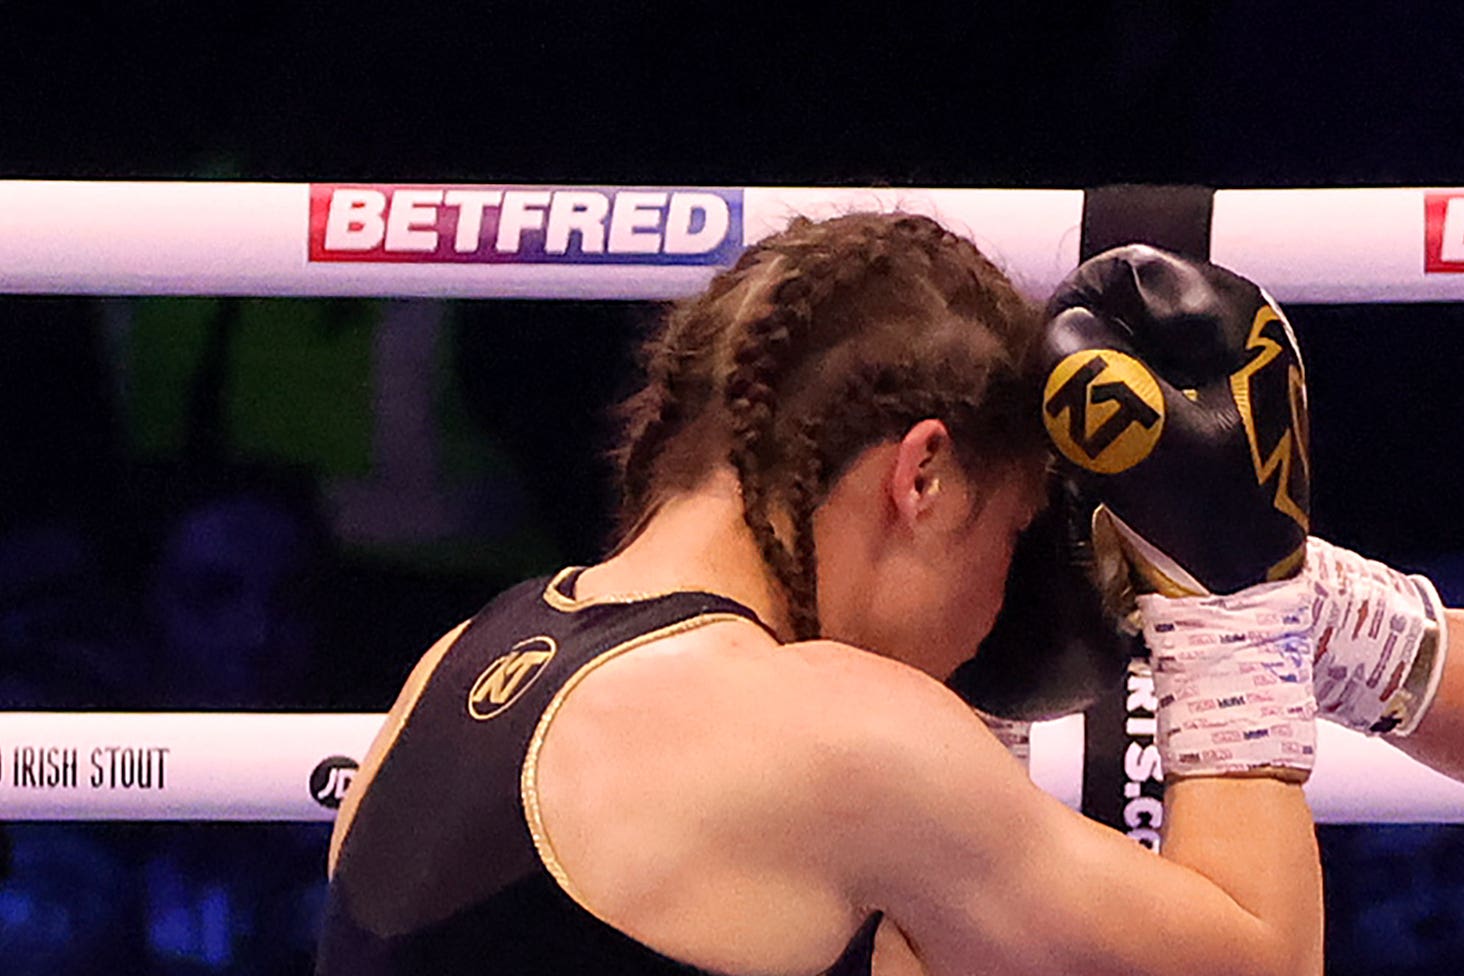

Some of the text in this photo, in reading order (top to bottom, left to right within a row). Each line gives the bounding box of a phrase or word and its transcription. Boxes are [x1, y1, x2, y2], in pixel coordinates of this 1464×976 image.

[323, 188, 730, 255] BETFRED
[13, 745, 170, 790] IRISH STOUT
